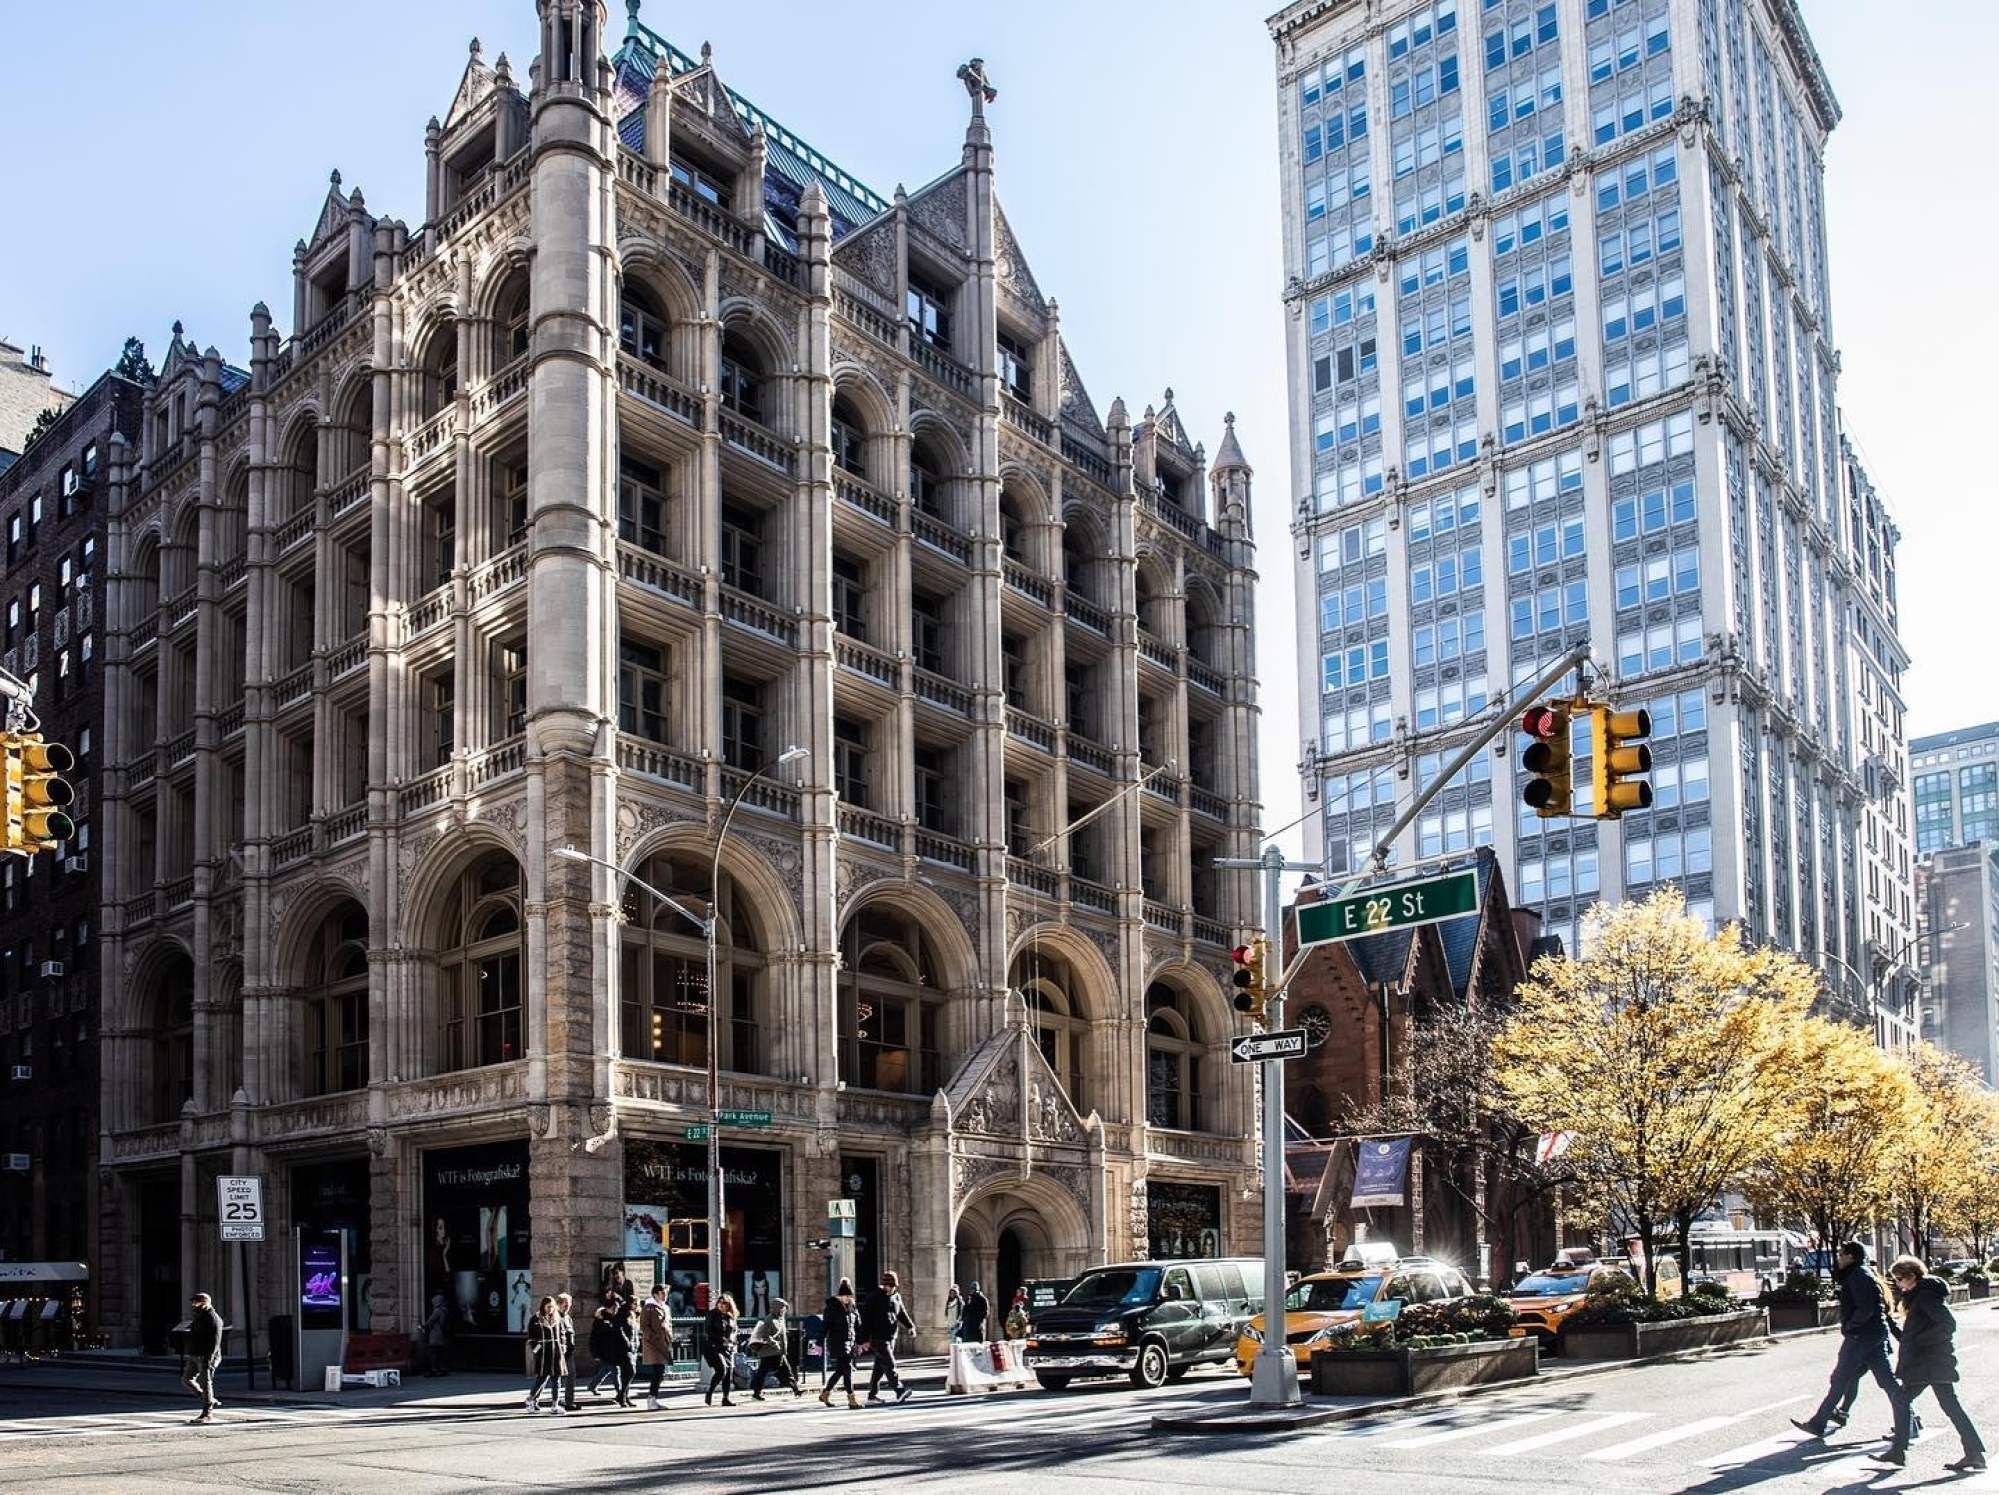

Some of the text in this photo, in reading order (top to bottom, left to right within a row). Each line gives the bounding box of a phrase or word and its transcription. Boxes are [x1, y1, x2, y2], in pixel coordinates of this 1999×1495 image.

[1345, 890, 1425, 929] E 22 St
[1240, 1037, 1298, 1056] ONE WAY
[719, 1112, 769, 1121] Park Avenue
[687, 1129, 692, 1139] E
[693, 1128, 701, 1139] 22
[438, 1170, 459, 1185] WTF
[643, 1163, 671, 1180] WTF
[676, 1168, 686, 1180] is
[226, 1202, 257, 1220] 25
